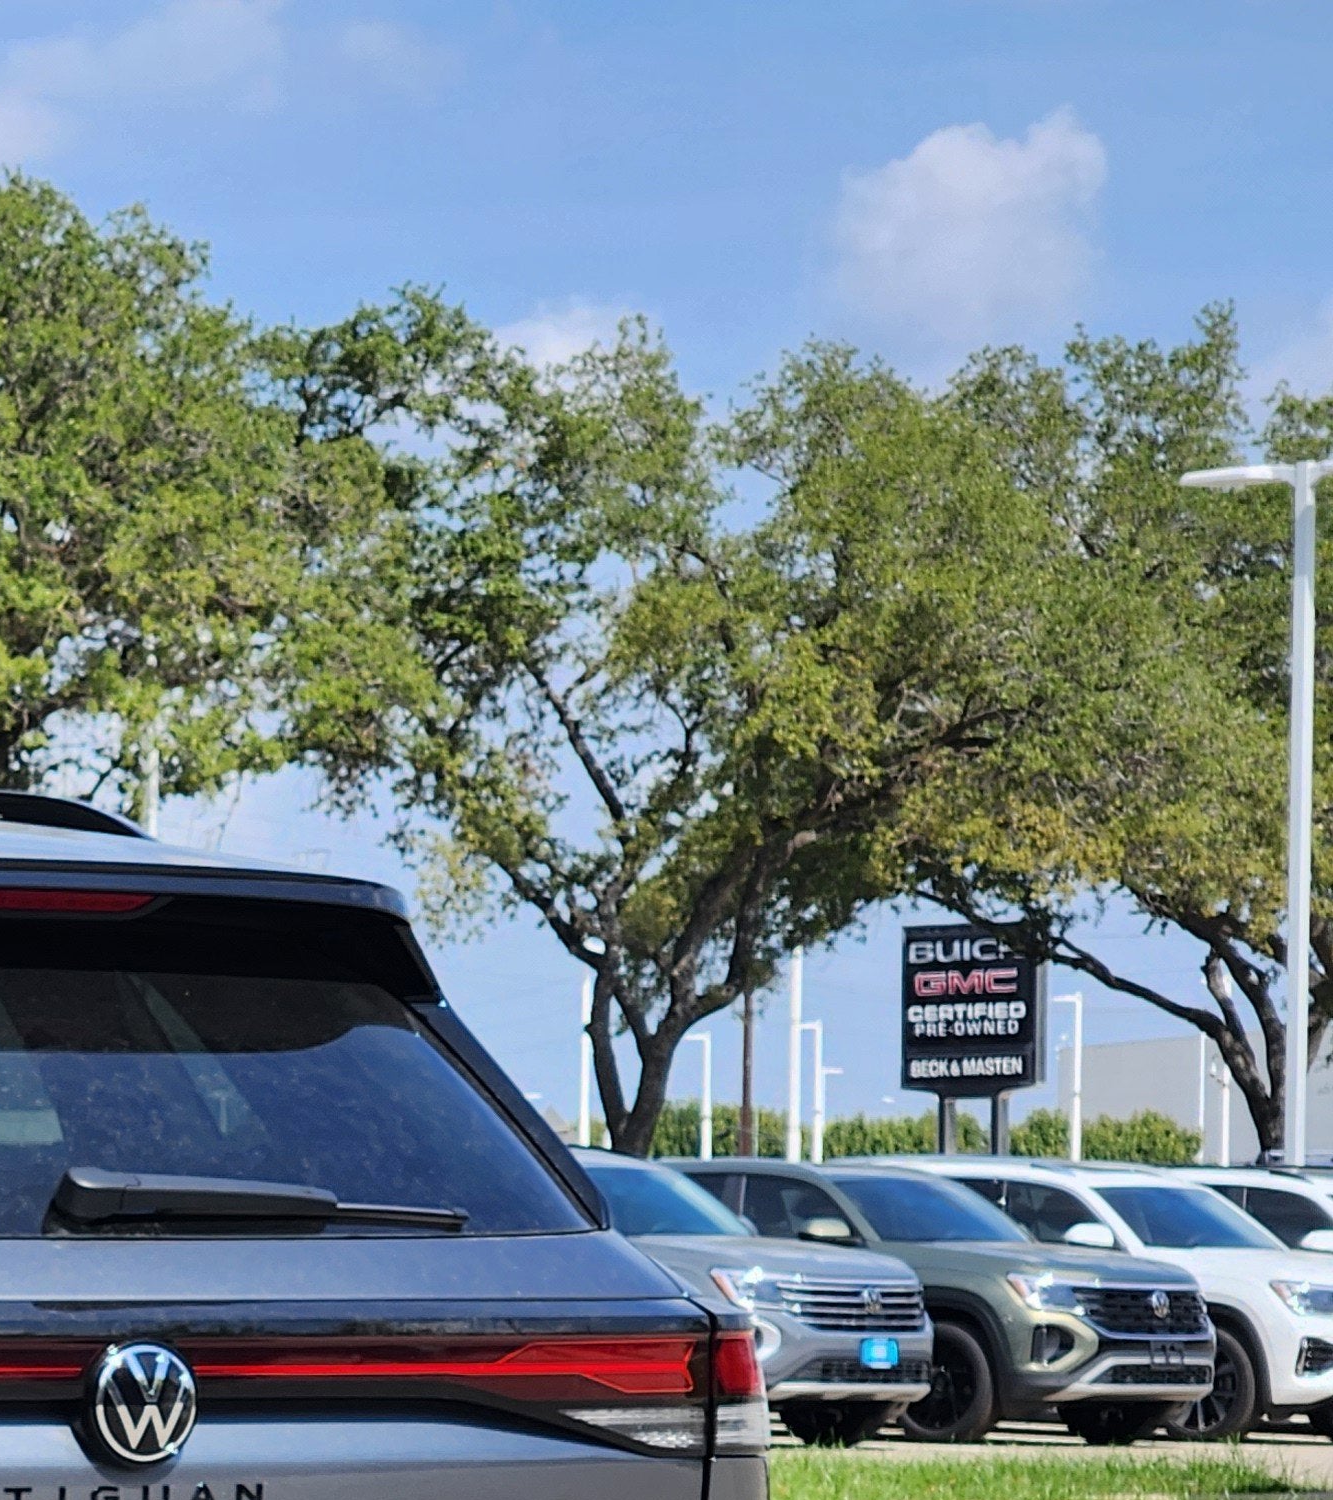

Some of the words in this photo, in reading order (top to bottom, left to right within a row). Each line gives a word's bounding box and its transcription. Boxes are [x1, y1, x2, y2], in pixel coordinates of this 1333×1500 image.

[914, 967, 1018, 996] GMC
[907, 1000, 1027, 1023] CERTIFIED
[914, 1020, 1020, 1037] PRE-OWNED
[910, 1059, 949, 1078] BECK
[950, 1061, 960, 1076] &
[962, 1055, 1023, 1076] MASTEN
